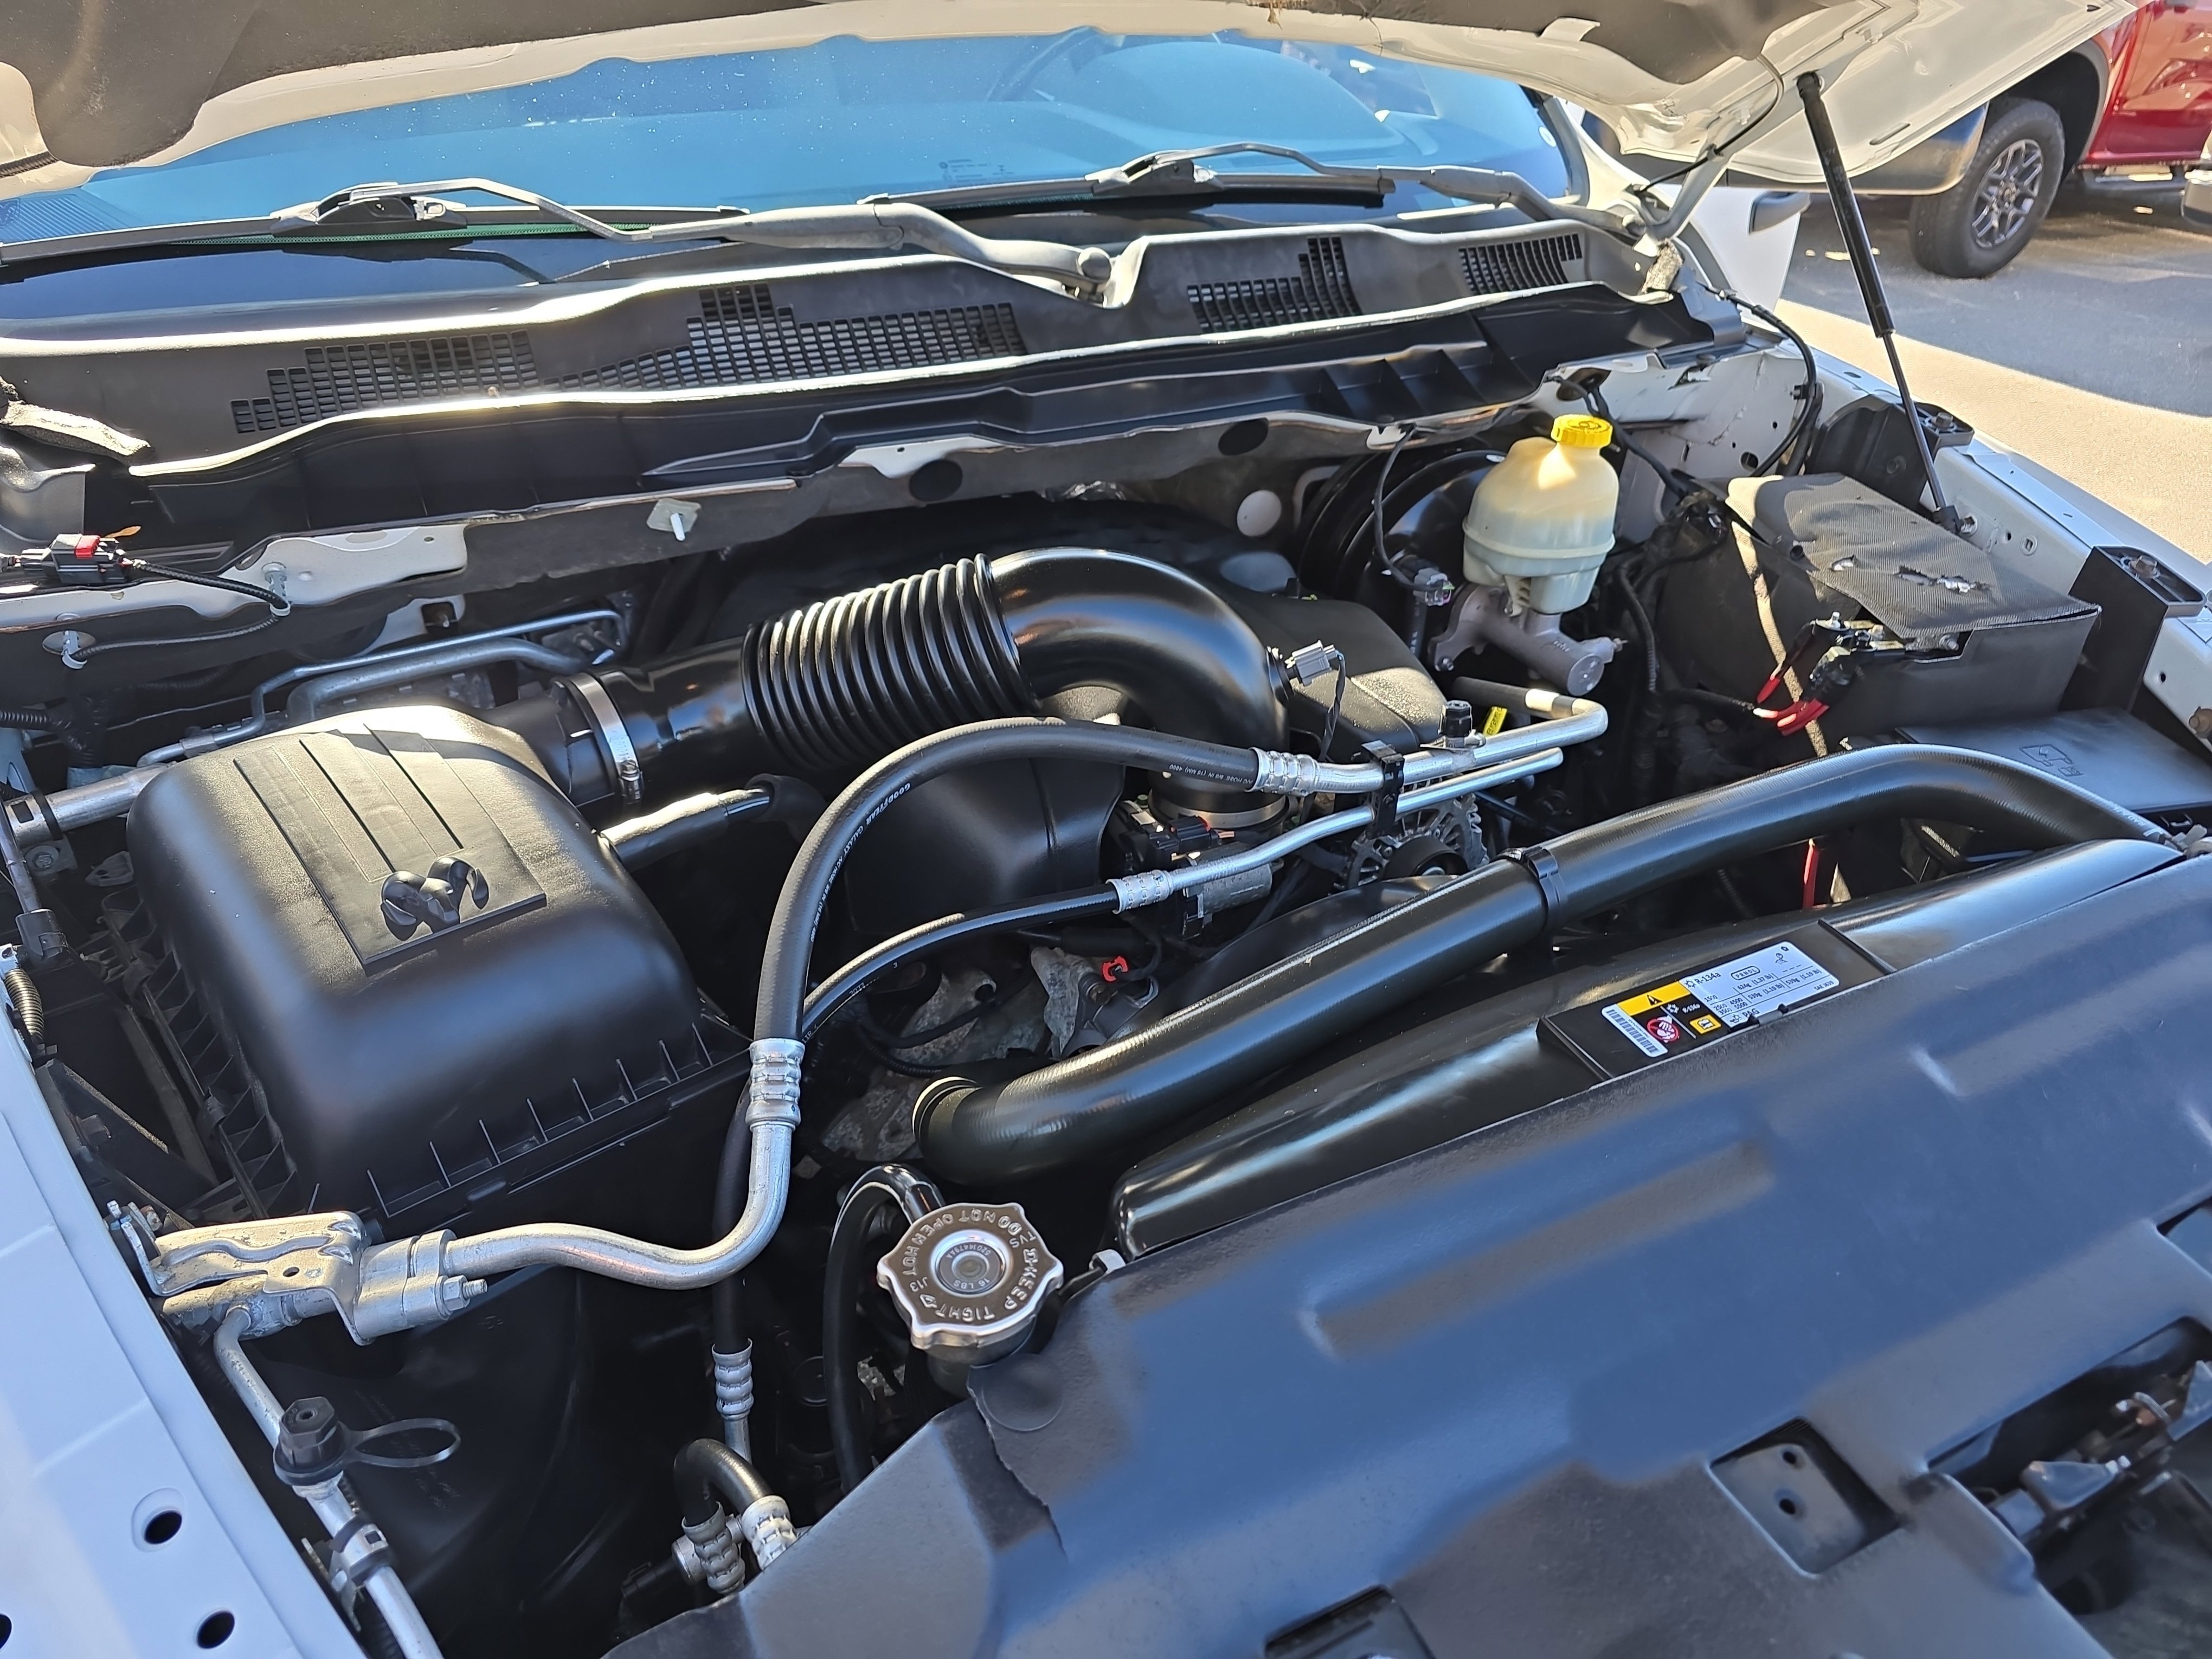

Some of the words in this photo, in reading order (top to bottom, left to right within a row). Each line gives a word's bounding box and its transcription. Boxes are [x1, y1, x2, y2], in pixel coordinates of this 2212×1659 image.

[866, 783, 911, 825] GOODYEAR
[843, 825, 864, 858] GALAXY
[828, 866, 838, 884] HOSE
[1694, 972, 1721, 985] R-134a
[1735, 968, 1757, 979] PRNDL
[1742, 1008, 1760, 1018] PAG
[958, 1209, 996, 1224] NOT
[911, 1213, 954, 1245] OPEN
[998, 1216, 1023, 1236] DO
[902, 1245, 921, 1276] HOT
[909, 1276, 929, 1292] J13
[953, 1279, 974, 1289] LBS
[978, 1277, 991, 1287] 16
[1004, 1265, 1038, 1310] KEEP
[935, 1304, 995, 1322] TIGHT
